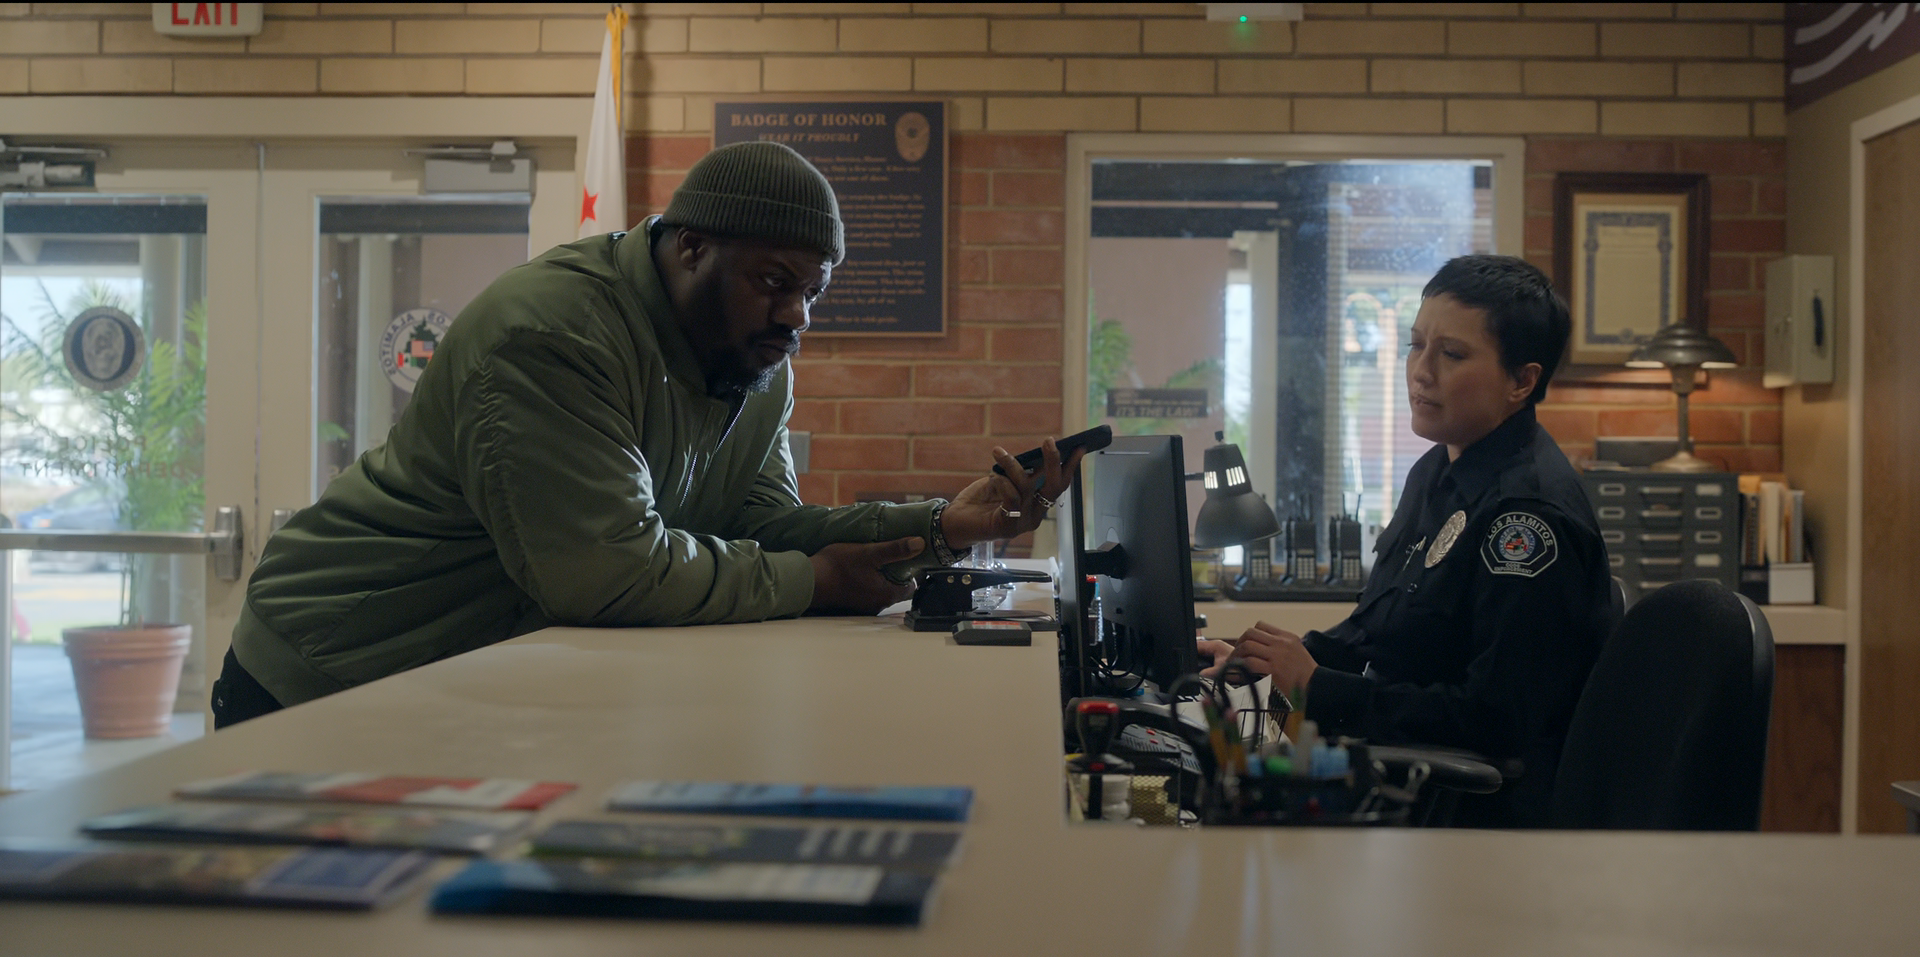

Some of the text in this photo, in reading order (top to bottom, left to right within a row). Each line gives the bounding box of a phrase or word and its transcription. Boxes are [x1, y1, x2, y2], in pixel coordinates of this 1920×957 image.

[730, 113, 887, 127] BADGE OF HONOR
[792, 132, 806, 142] IT
[807, 132, 859, 143] PROUDLY
[1487, 519, 1503, 540] LOS
[1505, 514, 1554, 547] ALAMITOS
